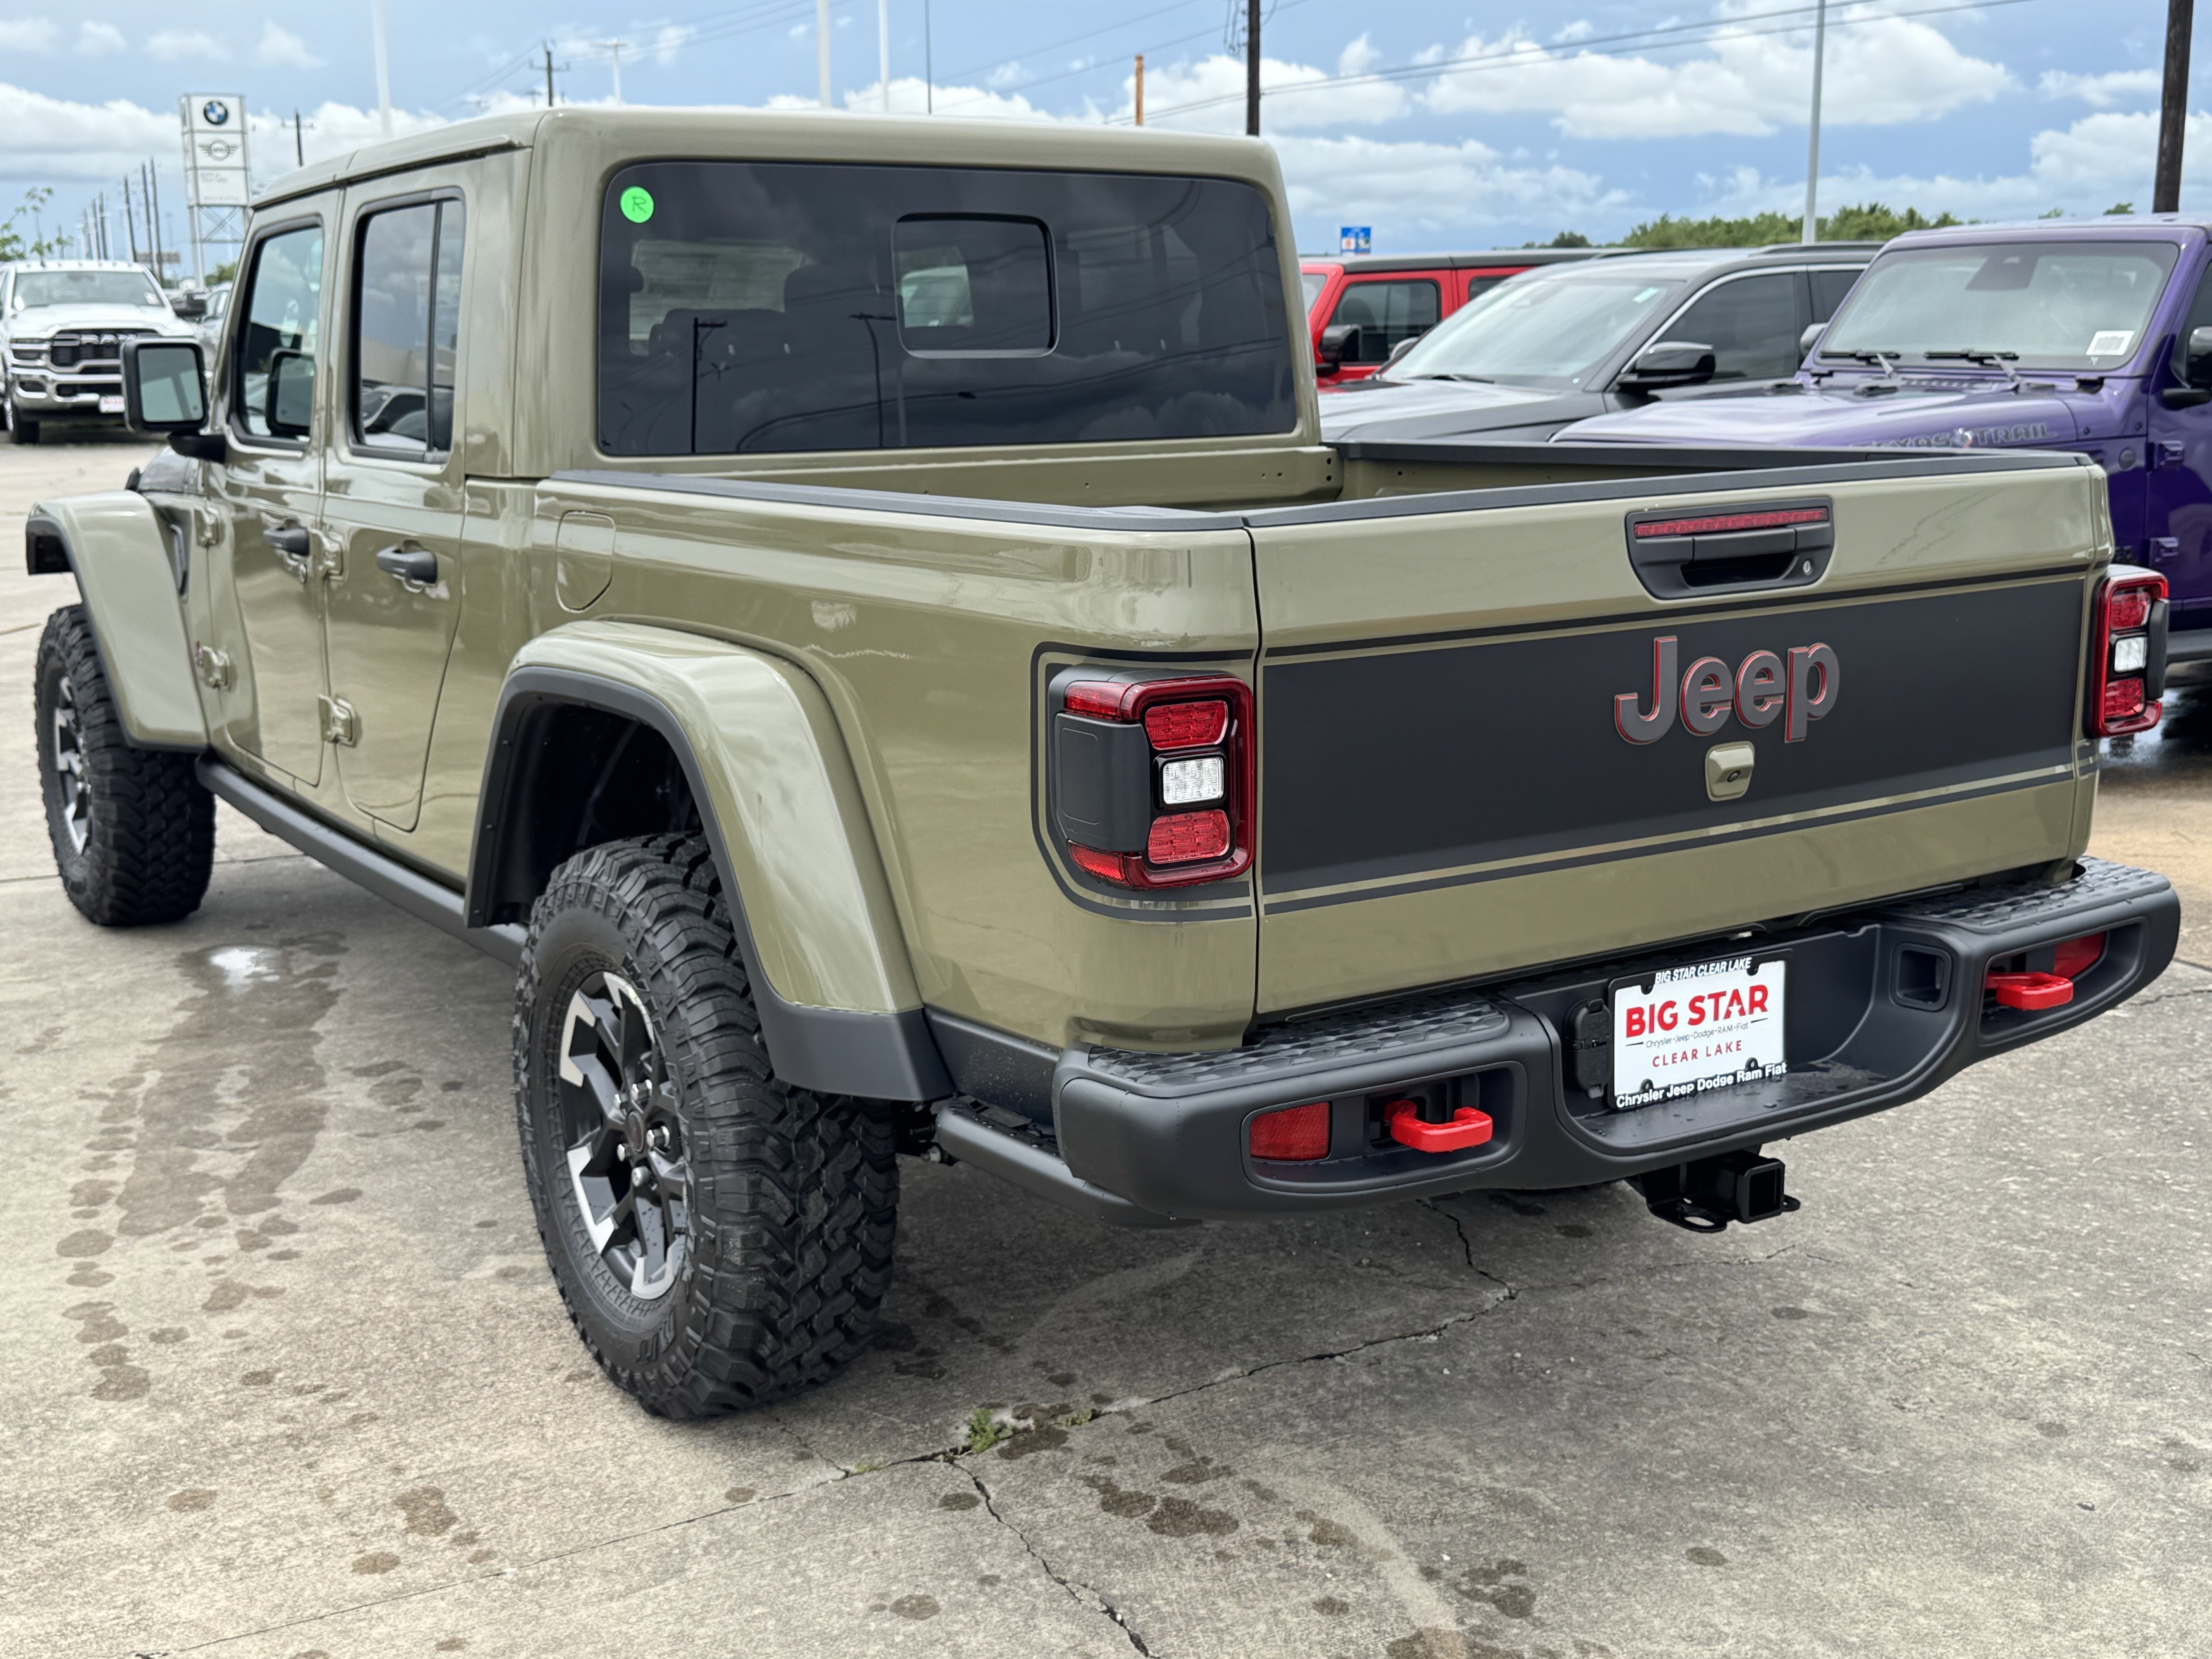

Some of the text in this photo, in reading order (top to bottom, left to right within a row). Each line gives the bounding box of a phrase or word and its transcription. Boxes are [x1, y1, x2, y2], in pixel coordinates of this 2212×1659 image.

[632, 196, 647, 214] R
[1976, 422, 2057, 446] TRAIL
[1614, 635, 1840, 745] Jeep
[1655, 957, 1752, 984] BIG STAR CLEAR LAKE
[1626, 984, 1768, 1038] BIG STAR
[1646, 1022, 1748, 1048] Chrysler Jeep Dodge RAM Fiat
[1652, 1040, 1742, 1067] CLEAR LAKE
[1616, 1062, 1787, 1108] Chrysler Jeep Dodge Ram Fiat
